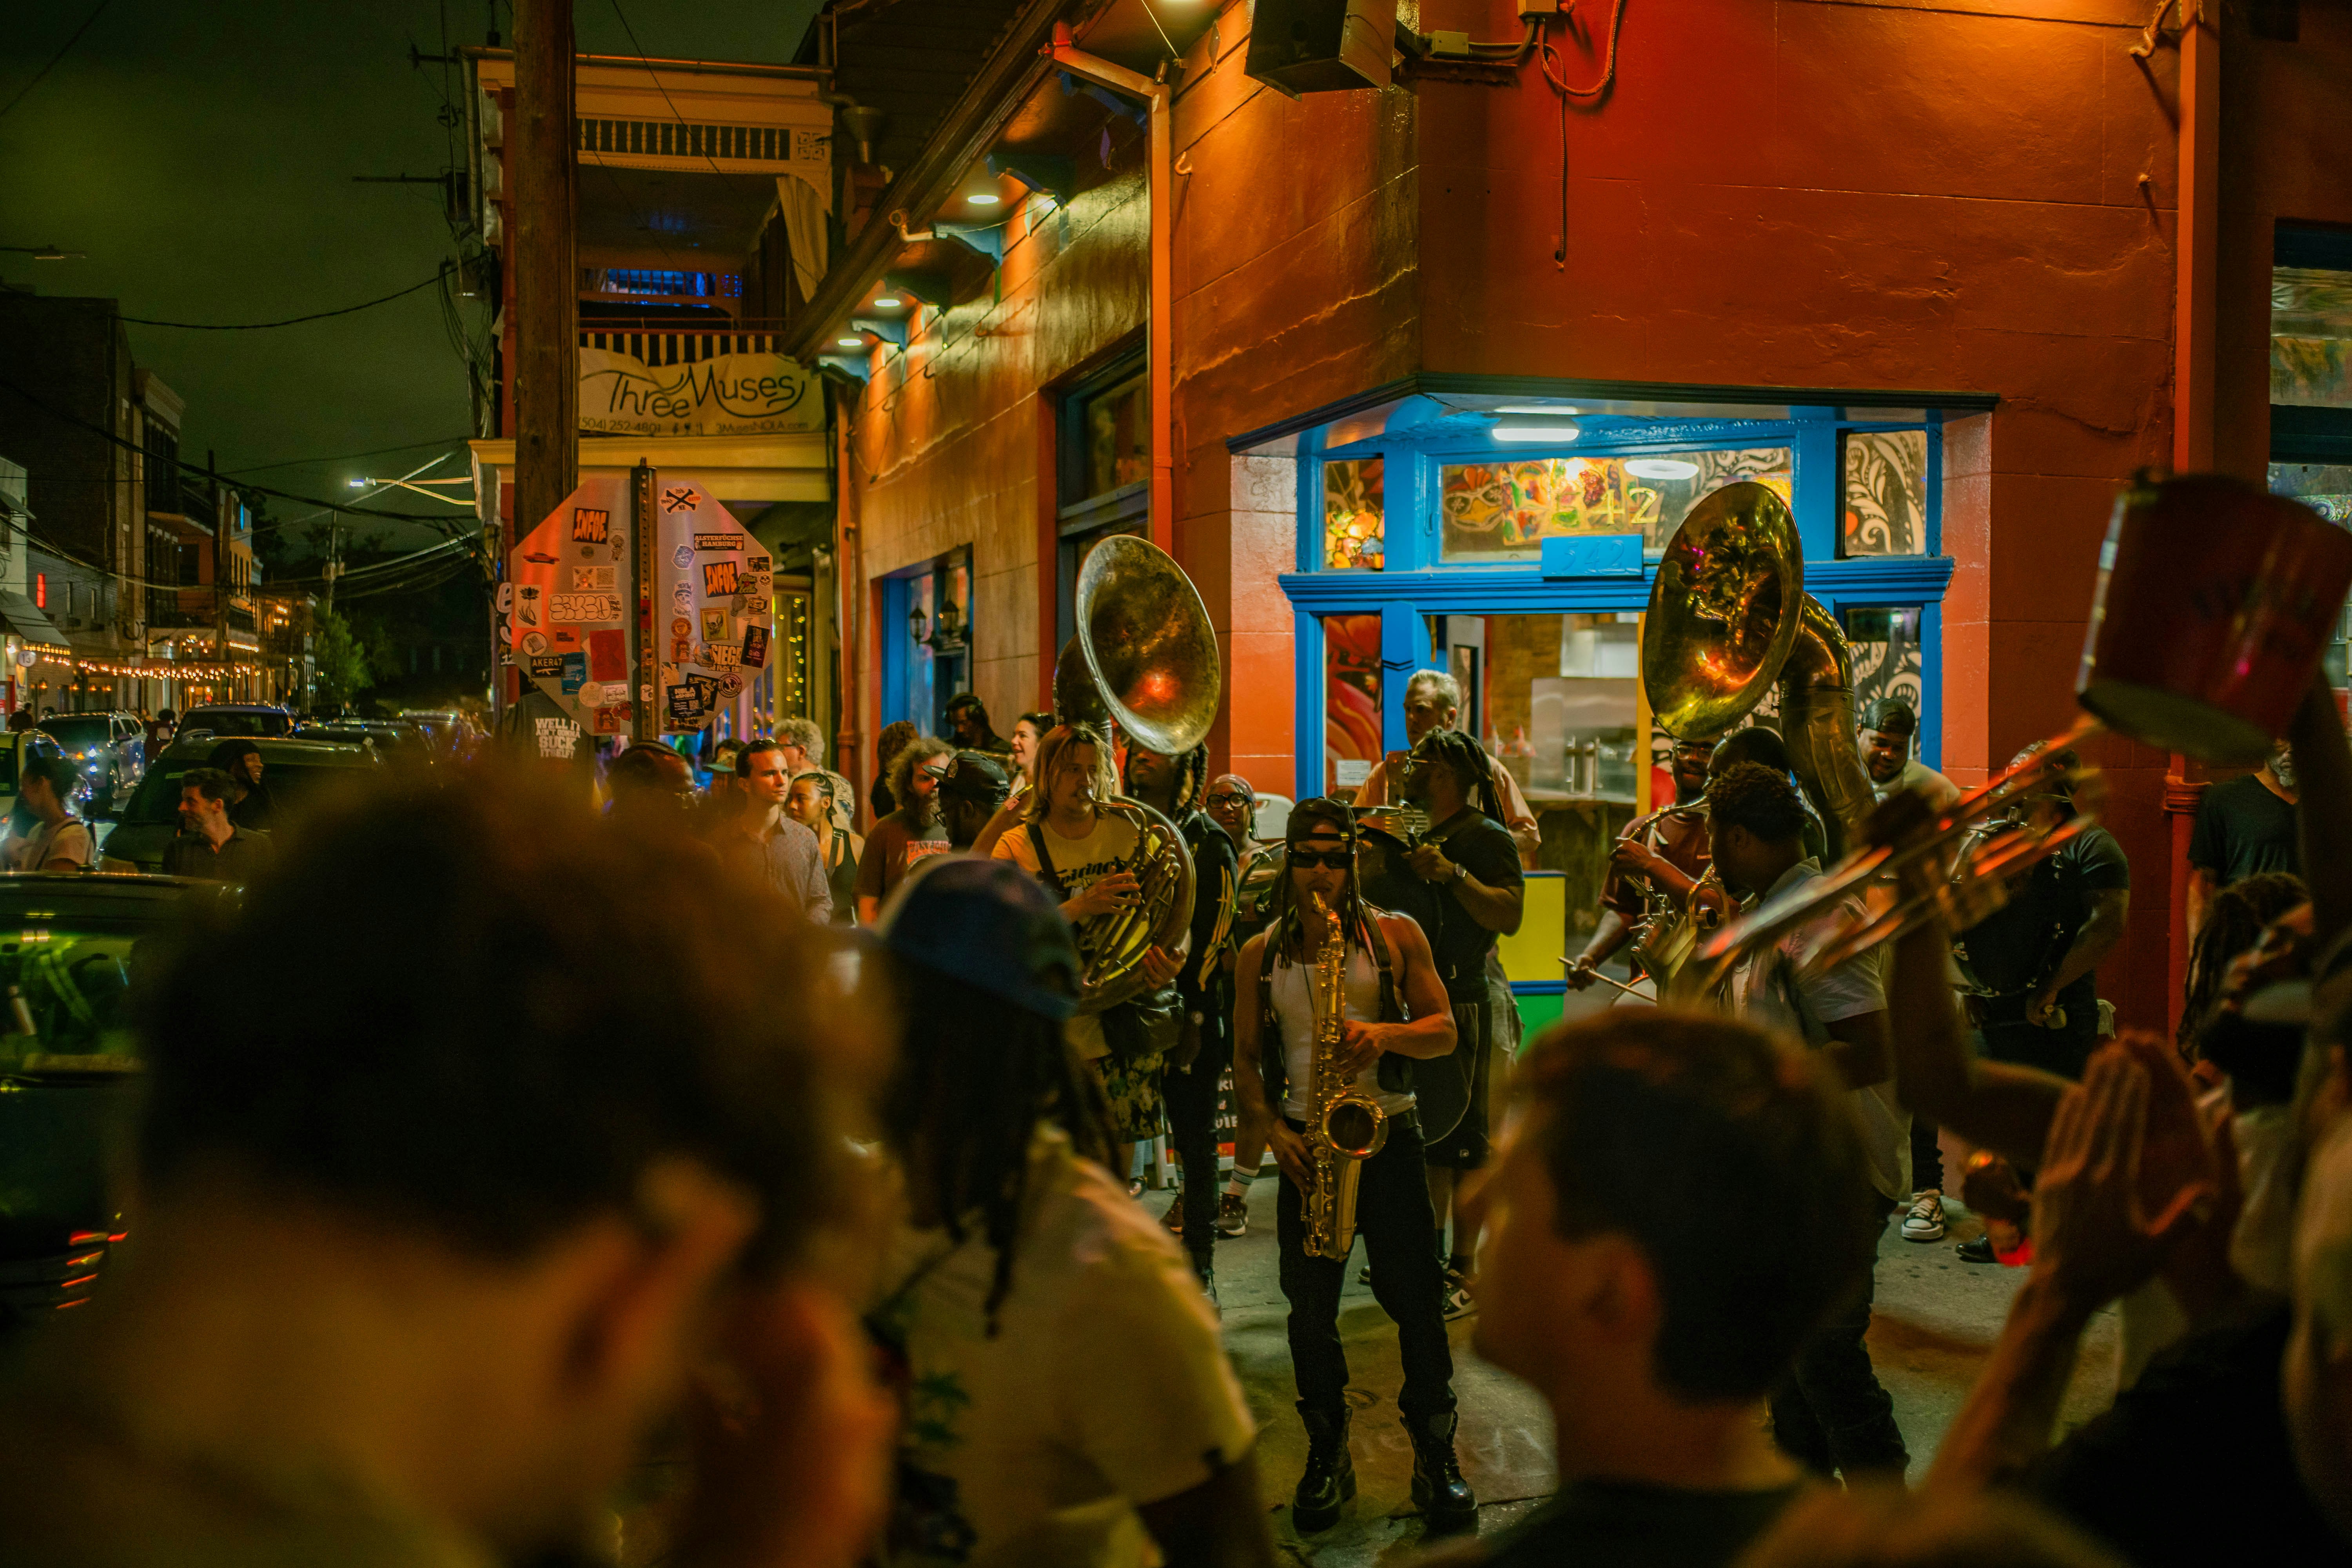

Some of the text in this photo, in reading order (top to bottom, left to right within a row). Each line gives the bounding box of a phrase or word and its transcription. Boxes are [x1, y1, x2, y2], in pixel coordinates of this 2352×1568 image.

[588, 365, 805, 418] Three Muses
[532, 658, 563, 666] AKER47
[535, 718, 568, 730] WELL
